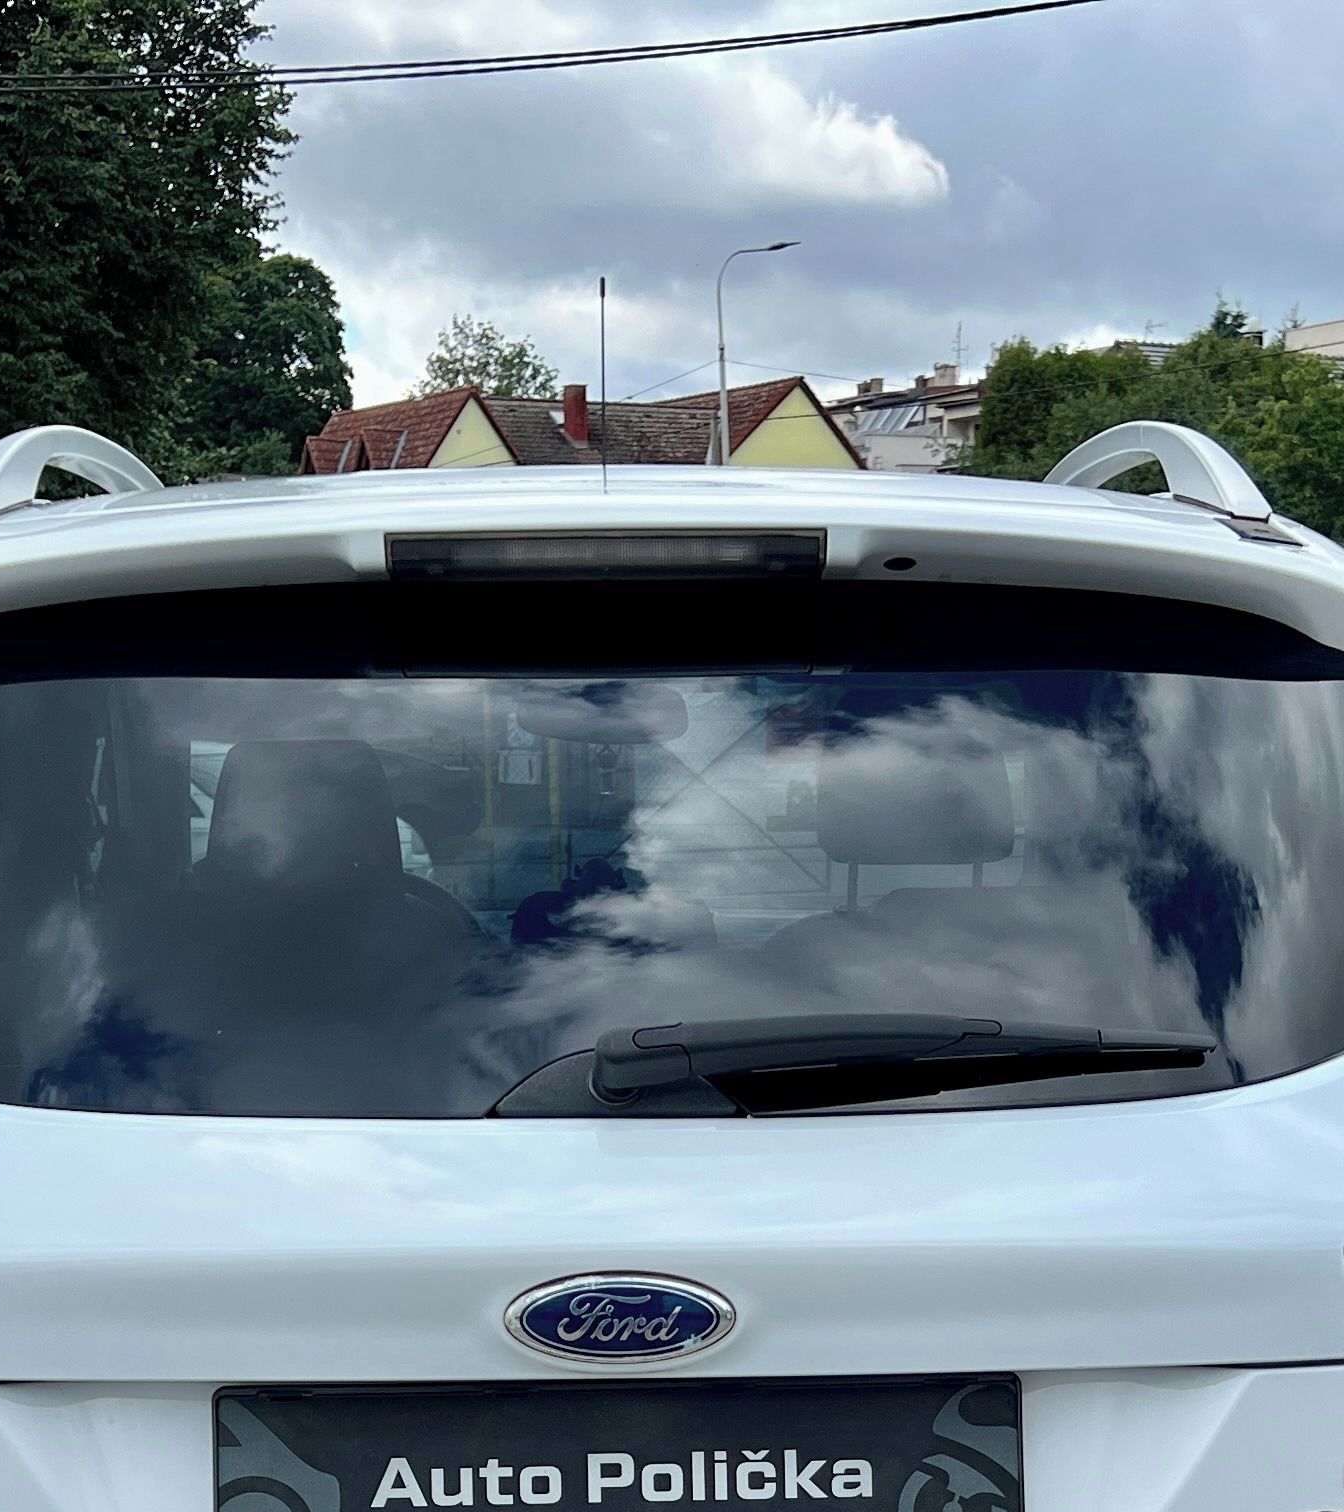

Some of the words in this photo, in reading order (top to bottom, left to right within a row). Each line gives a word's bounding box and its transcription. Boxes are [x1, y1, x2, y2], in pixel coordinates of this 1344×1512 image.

[557, 1293, 680, 1343] Ford
[370, 1457, 562, 1509] Auto
[587, 1449, 874, 1504] Polička
